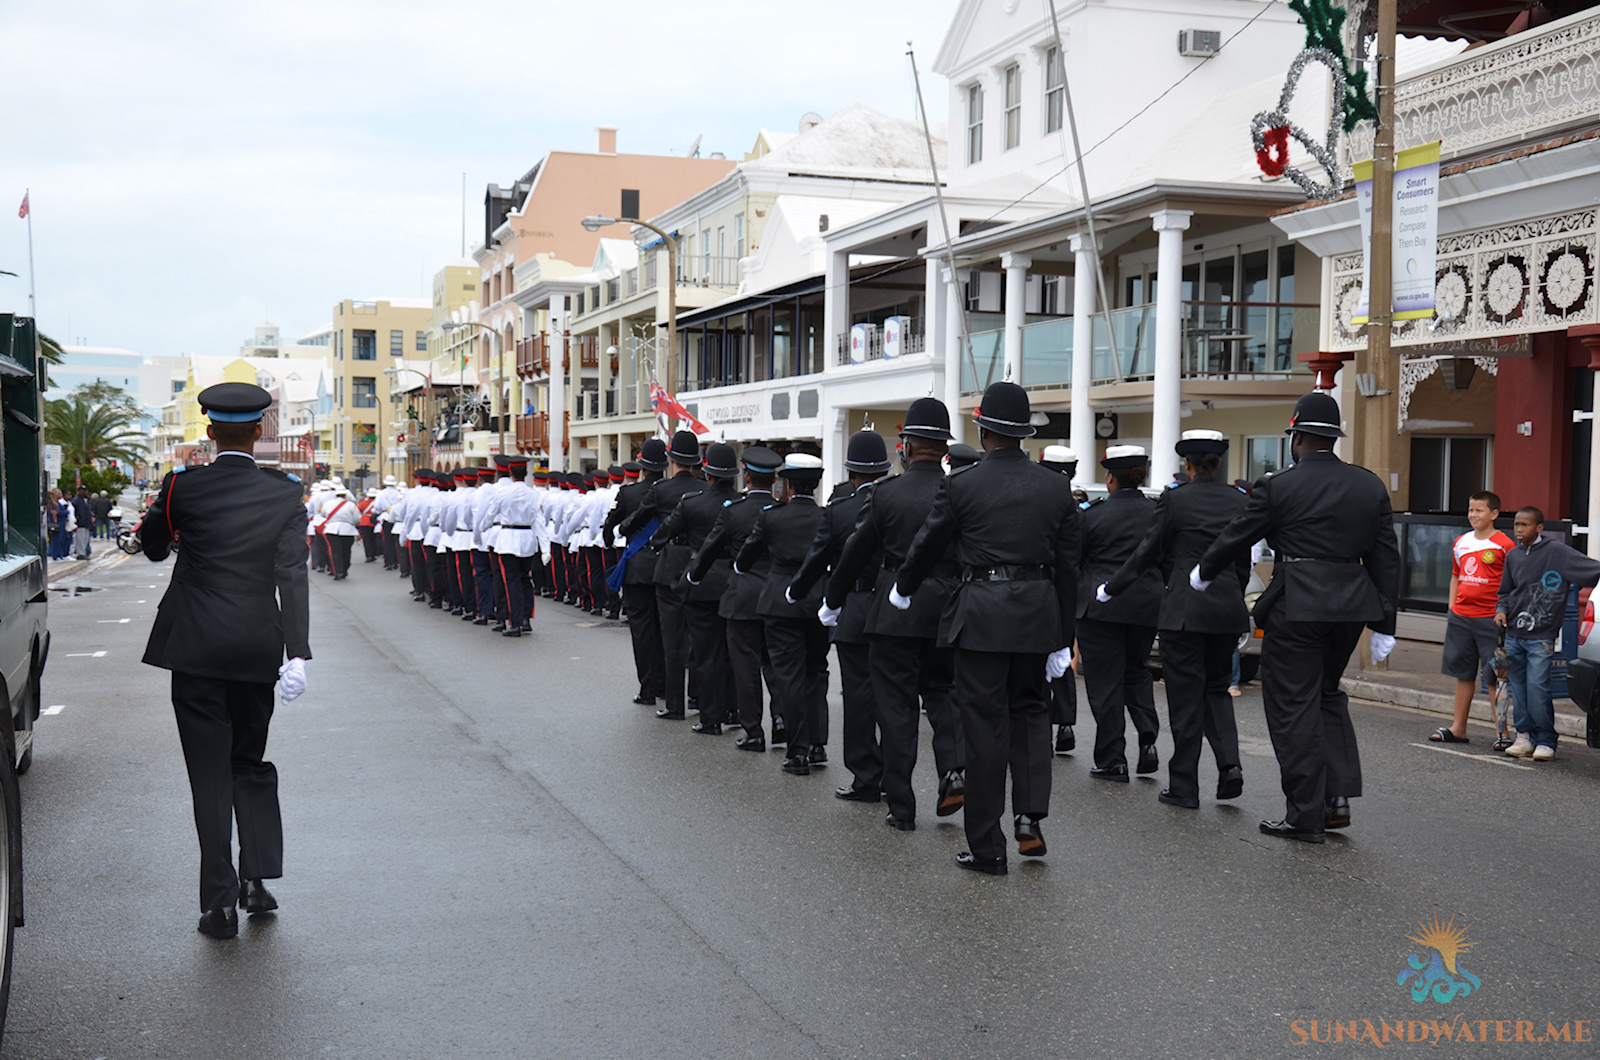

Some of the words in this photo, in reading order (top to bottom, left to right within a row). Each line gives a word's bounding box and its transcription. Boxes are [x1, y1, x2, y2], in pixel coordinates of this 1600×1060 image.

[1406, 178, 1427, 189] Smart
[1396, 187, 1434, 200] Consumers
[1400, 203, 1429, 216] Research
[1399, 221, 1427, 233] Compare
[1399, 238, 1413, 248] Then
[1414, 236, 1427, 248] Buy
[731, 403, 761, 417] DICKINSON
[1551, 659, 1567, 667] TER
